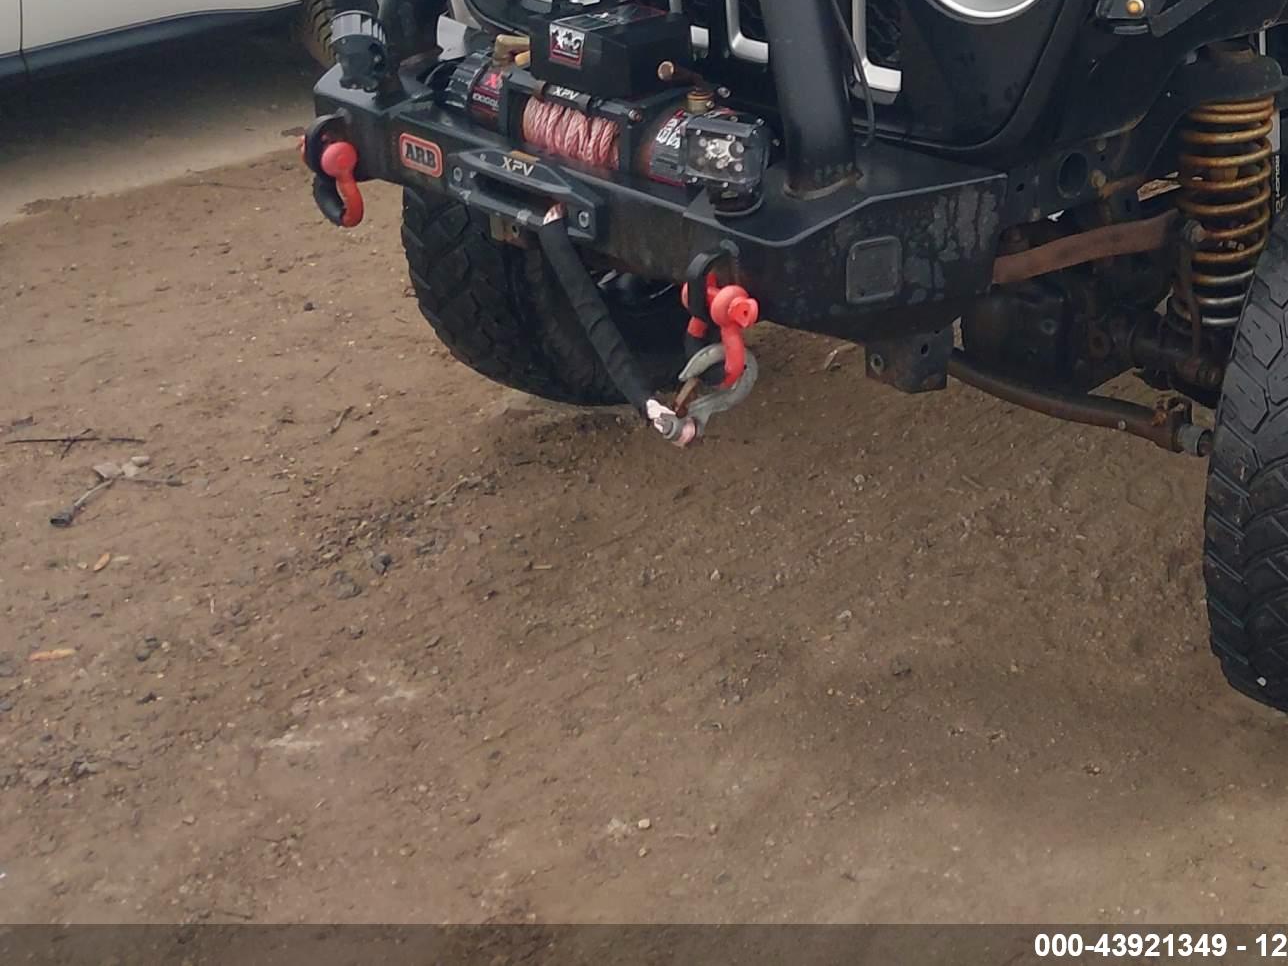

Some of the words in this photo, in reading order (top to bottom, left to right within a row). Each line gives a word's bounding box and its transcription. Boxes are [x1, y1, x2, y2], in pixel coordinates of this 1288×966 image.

[552, 86, 579, 100] XPV
[404, 141, 437, 170] ARB
[501, 155, 535, 177] XPV
